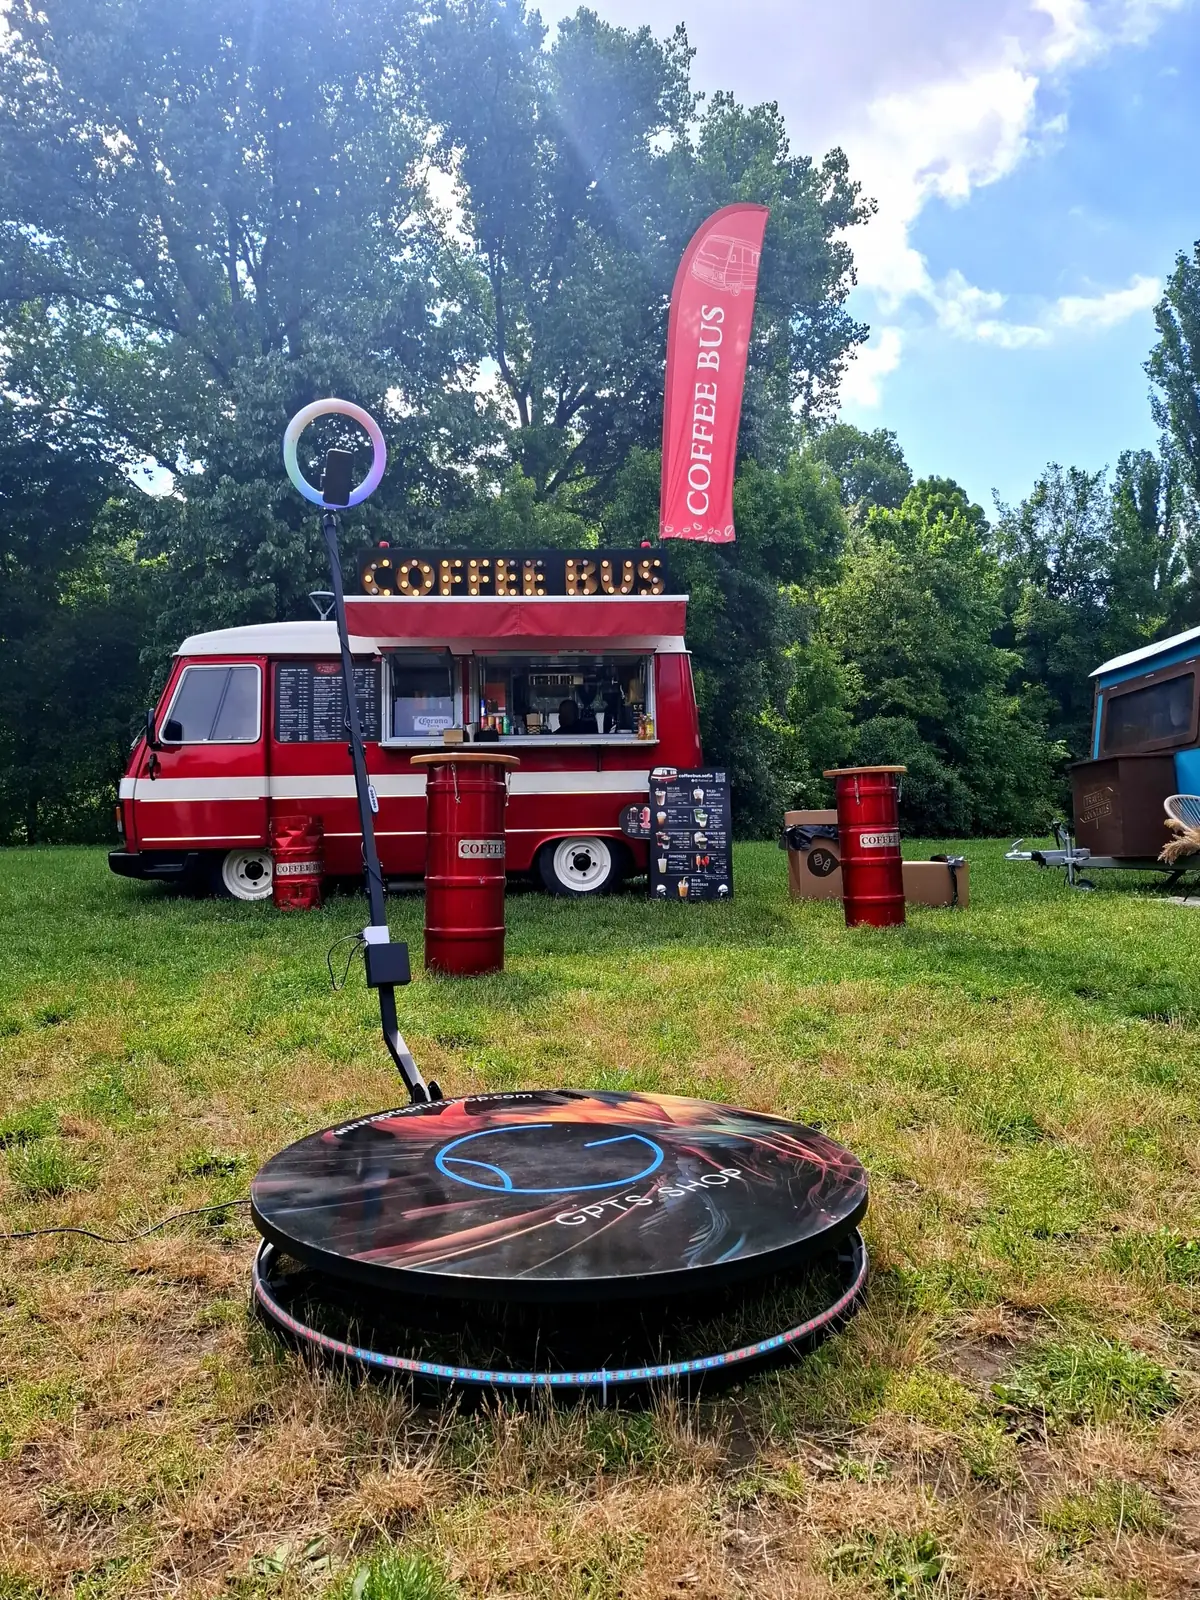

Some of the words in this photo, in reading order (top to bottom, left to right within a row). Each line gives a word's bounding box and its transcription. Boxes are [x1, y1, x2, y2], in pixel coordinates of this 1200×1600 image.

[696, 304, 725, 372] BUS
[686, 382, 718, 516] COFFEE
[361, 558, 546, 596] COFFEE
[565, 558, 666, 596] BUS
[419, 717, 448, 725] Corona
[555, 1195, 653, 1226] GPTS
[657, 1168, 742, 1198] SHOP
